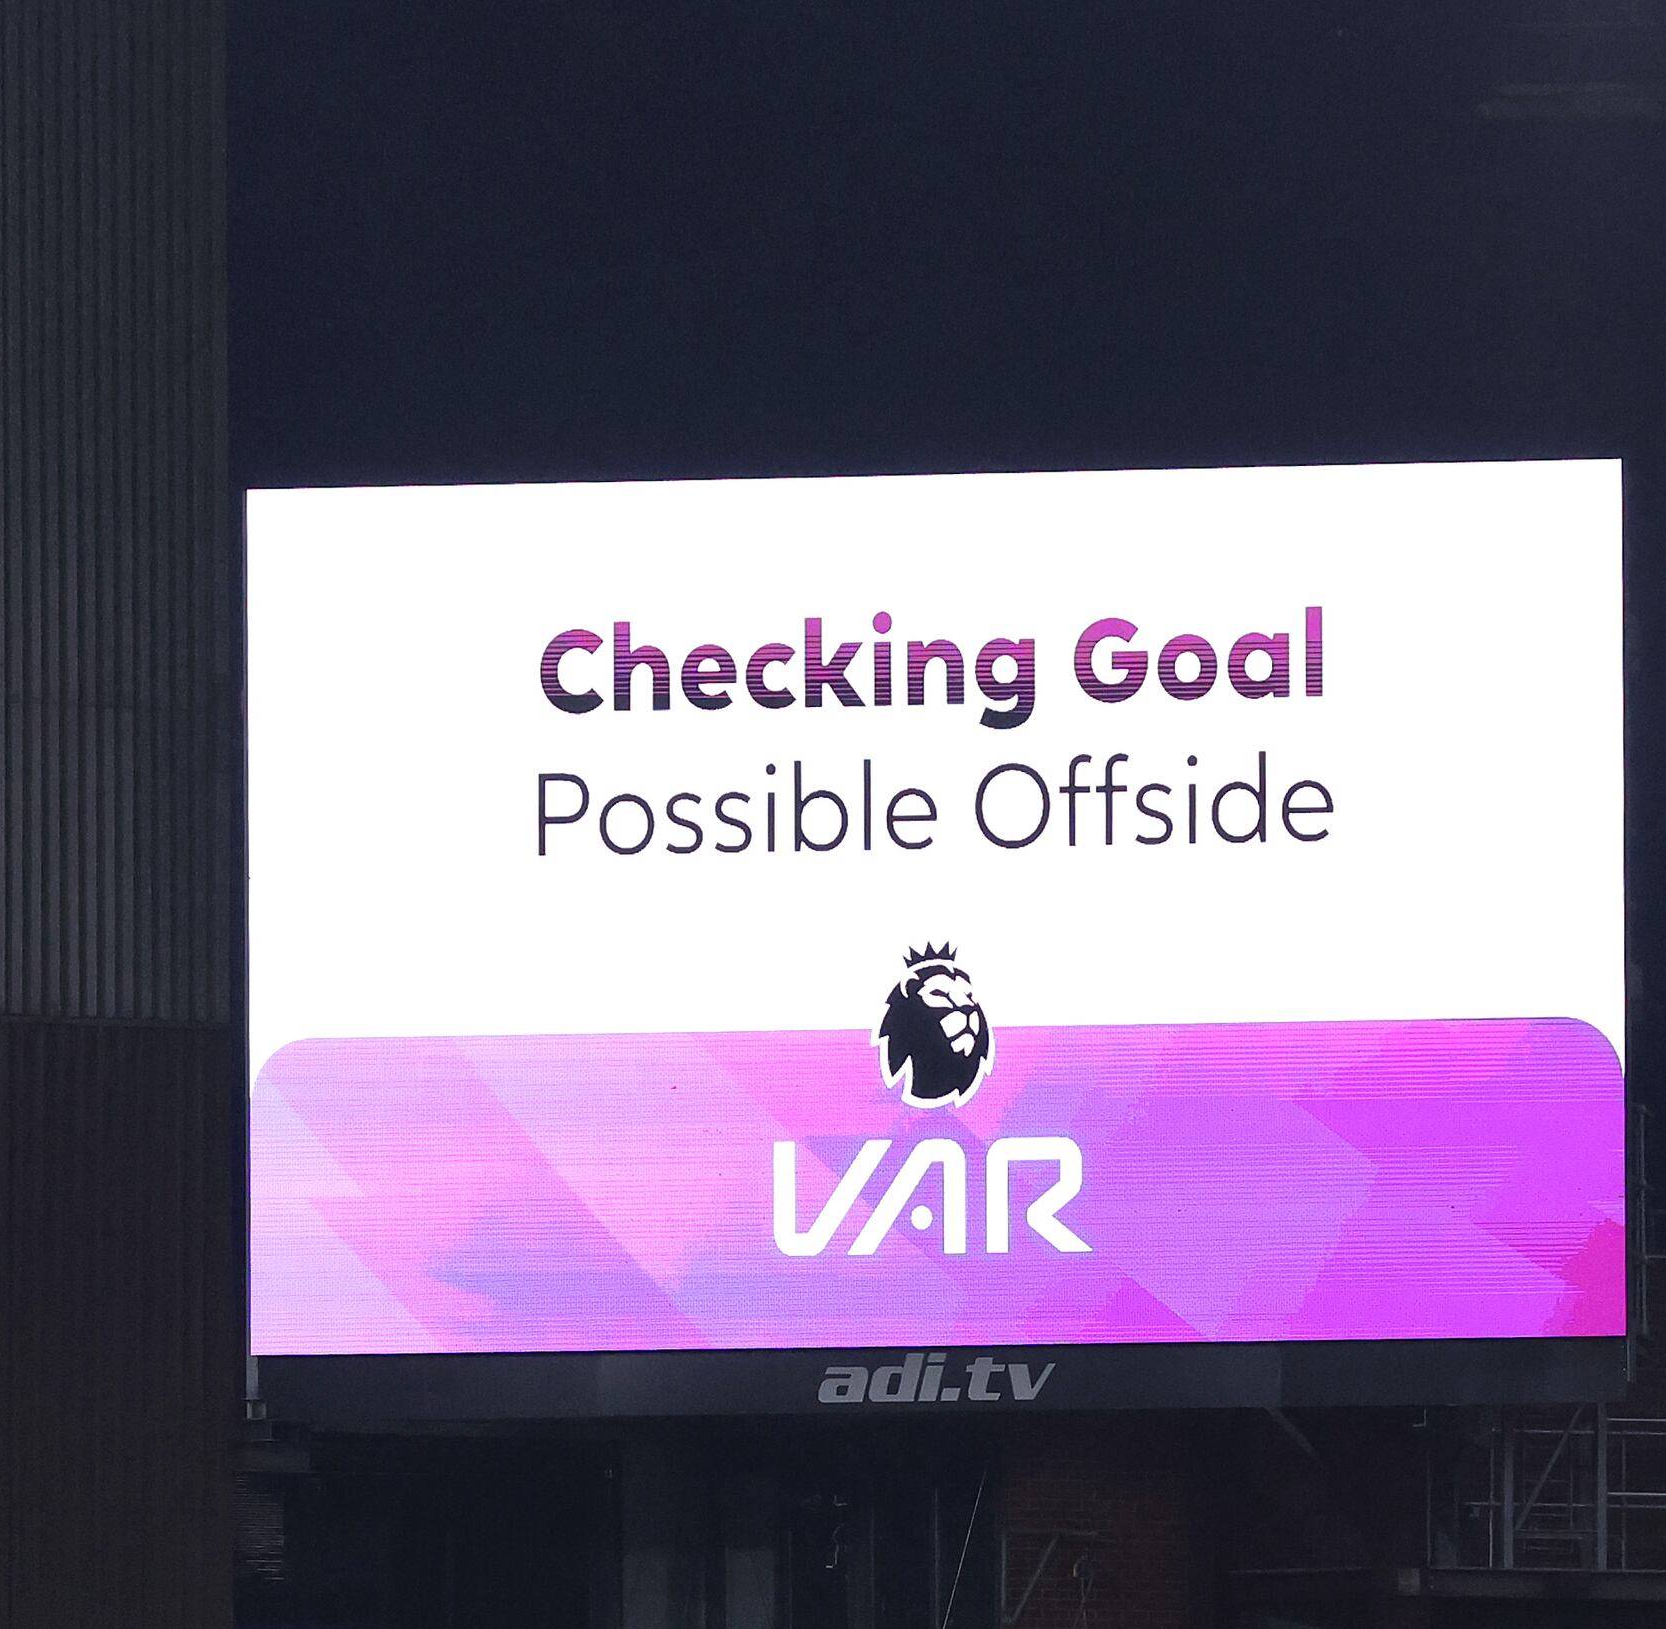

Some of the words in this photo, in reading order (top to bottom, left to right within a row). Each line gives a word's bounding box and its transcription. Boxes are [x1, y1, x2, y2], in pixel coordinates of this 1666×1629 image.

[539, 611, 1036, 729] Checking
[1074, 605, 1327, 704] Goal
[535, 757, 939, 857] Possible
[974, 750, 1335, 850] Offside
[772, 1135, 1095, 1256] VAR
[817, 1350, 1056, 1404] adi.tv
